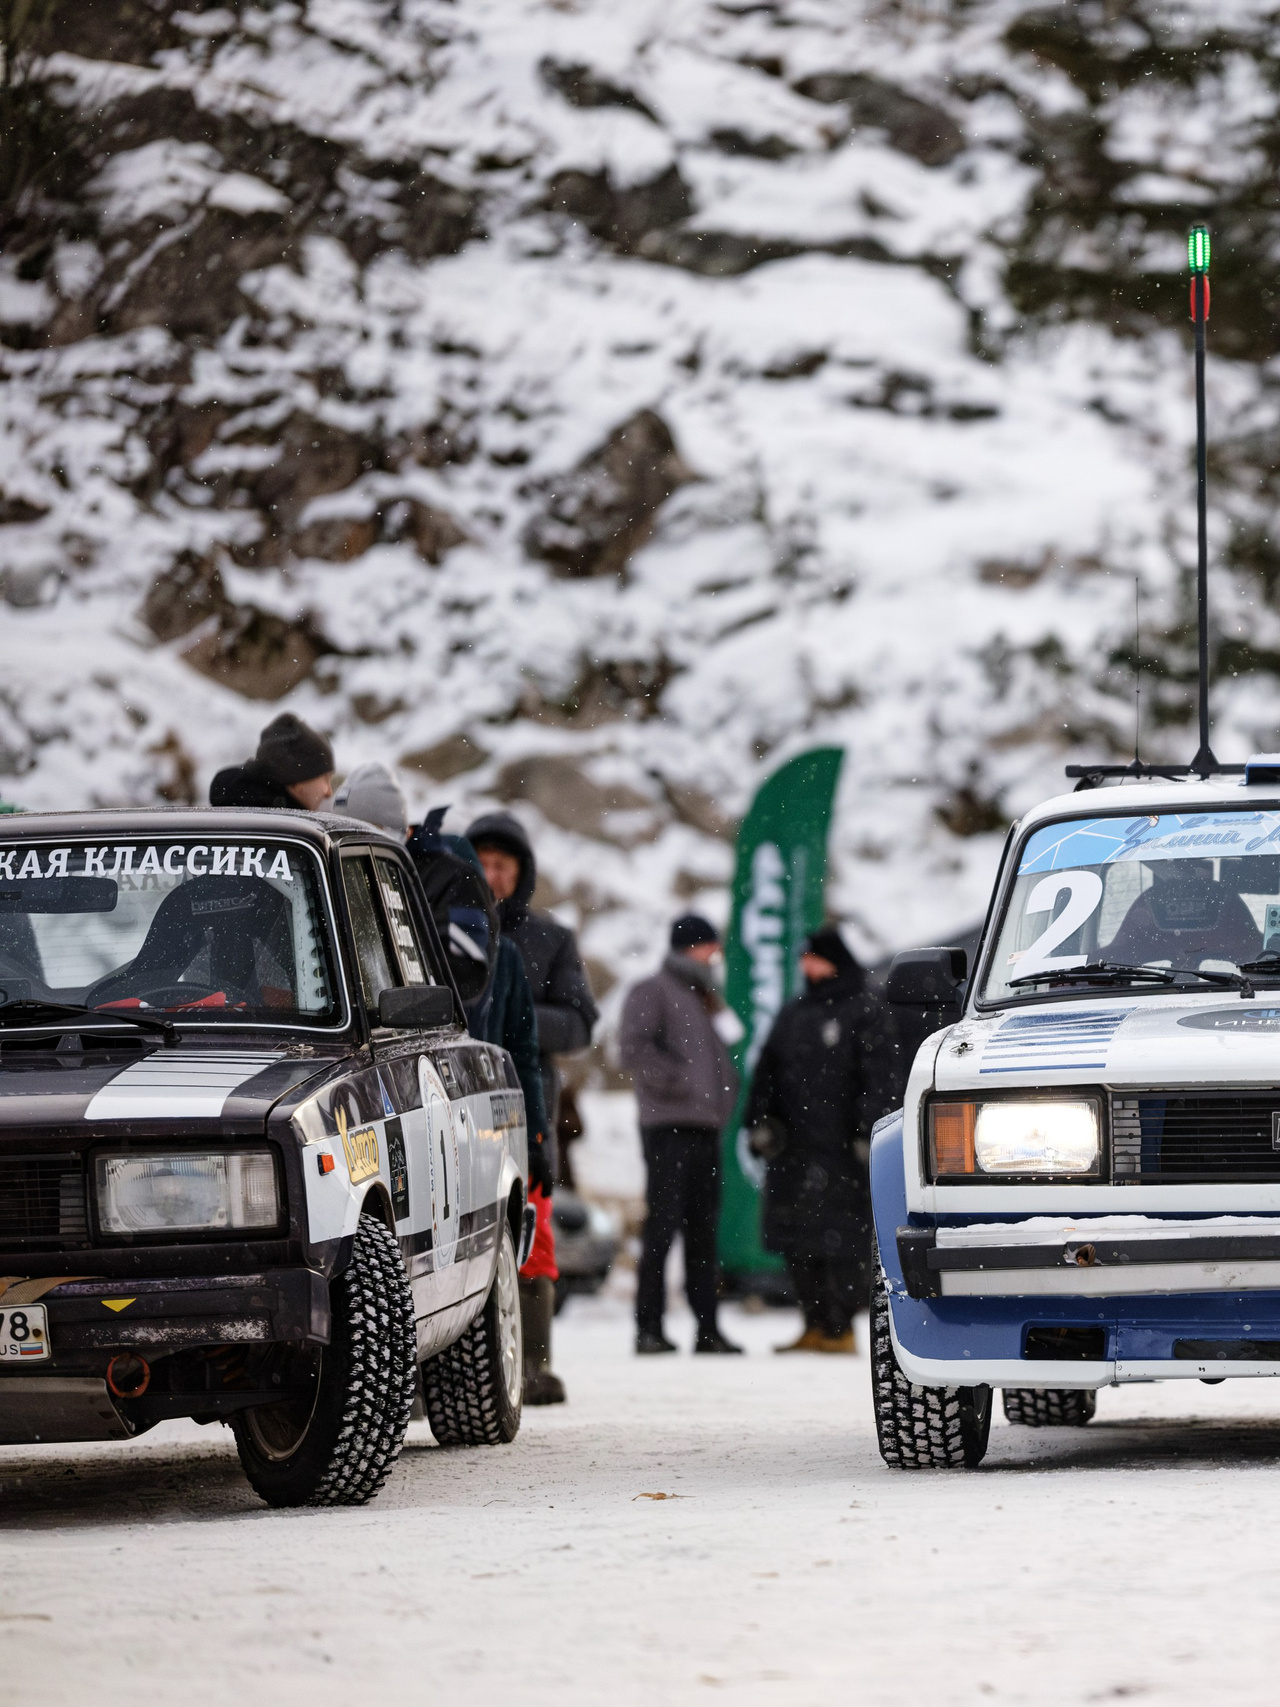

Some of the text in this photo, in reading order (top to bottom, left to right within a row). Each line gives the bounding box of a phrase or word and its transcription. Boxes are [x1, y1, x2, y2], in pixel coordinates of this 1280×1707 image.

[81, 845, 294, 881] КЛАССИКА
[1011, 870, 1103, 982] 2
[440, 1129, 450, 1221] 1
[0, 1311, 30, 1342] 8
